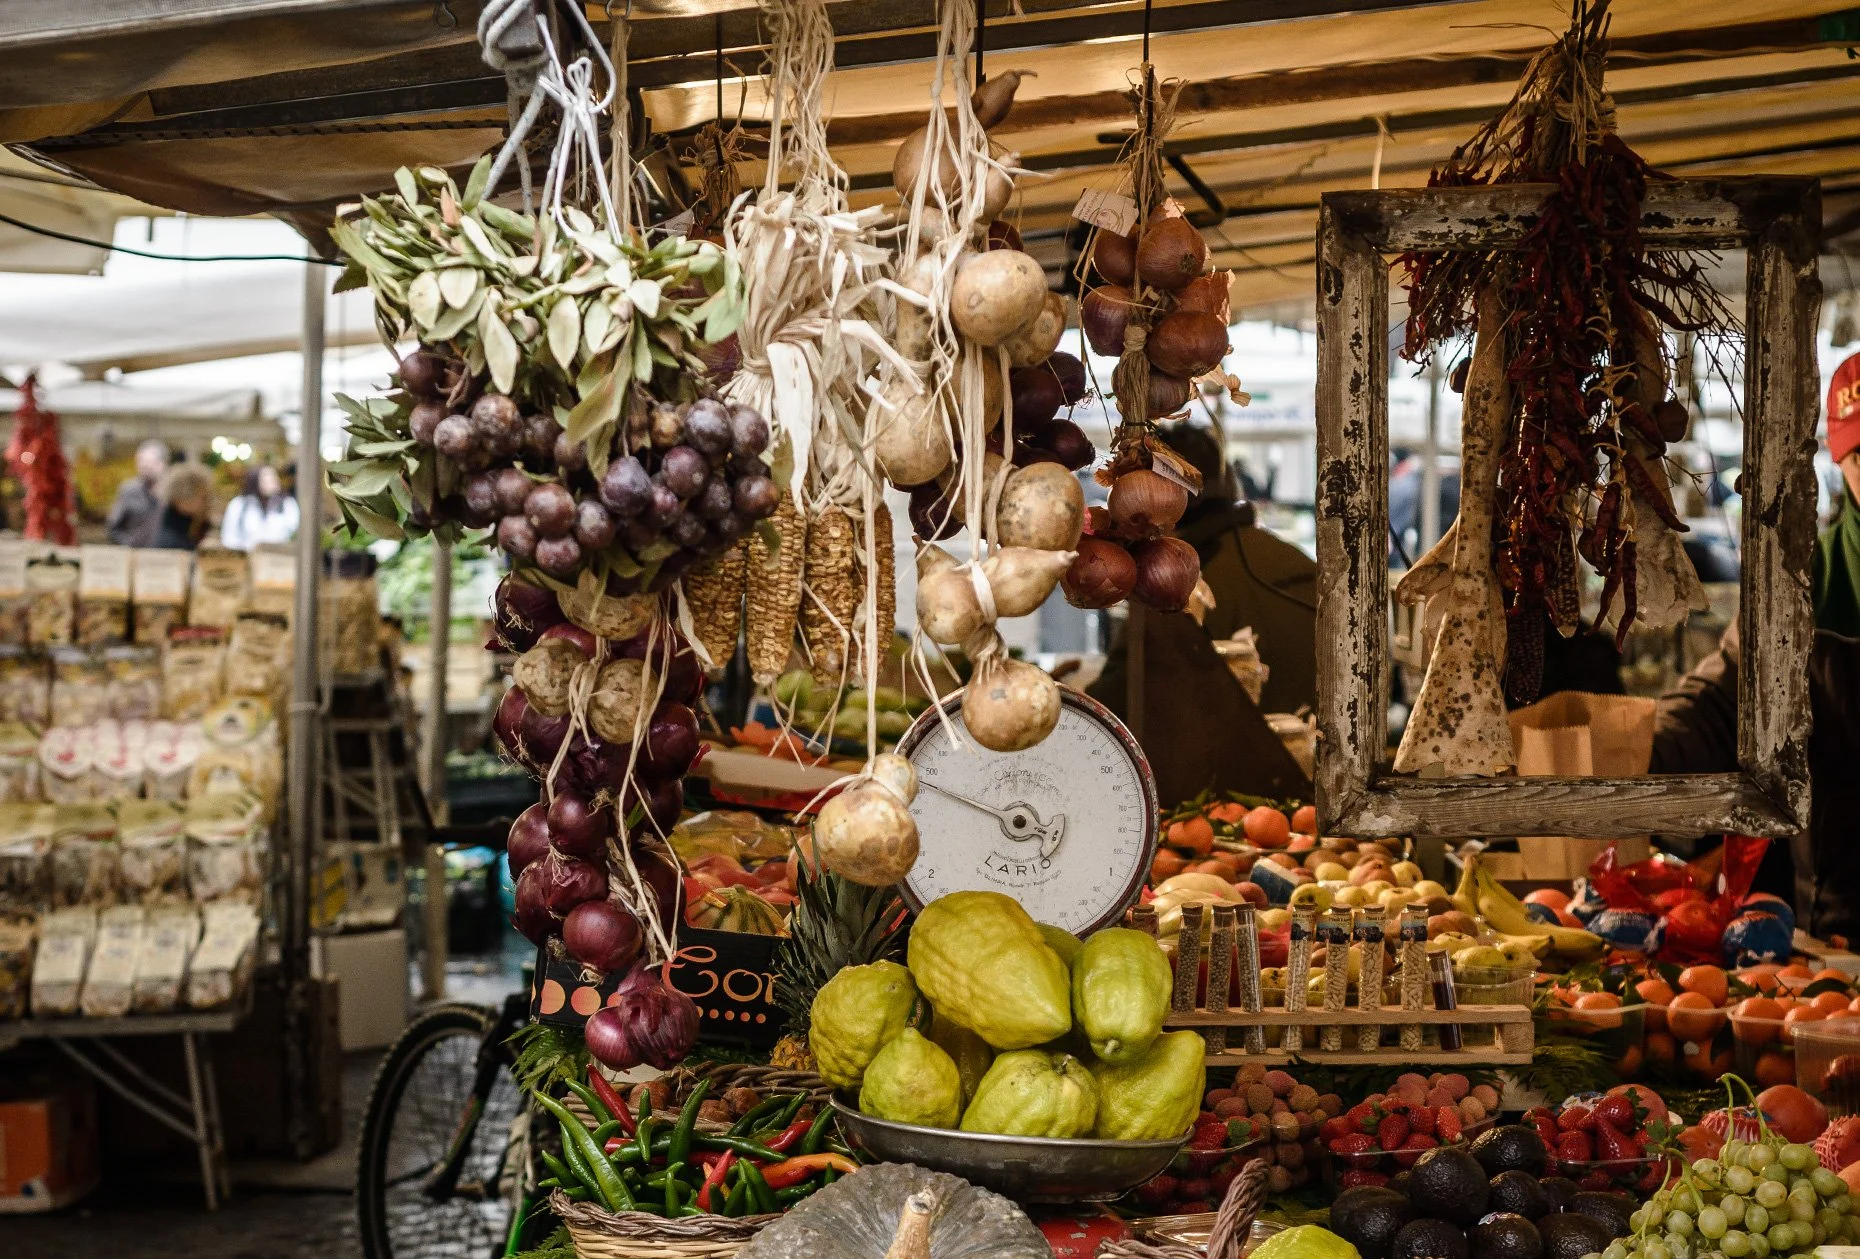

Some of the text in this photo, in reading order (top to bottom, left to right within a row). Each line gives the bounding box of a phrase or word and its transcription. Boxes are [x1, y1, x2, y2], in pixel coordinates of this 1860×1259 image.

[925, 767, 938, 776] 500
[1100, 765, 1113, 774] 500
[984, 855, 1051, 876] LARIO
[928, 868, 935, 879] 2
